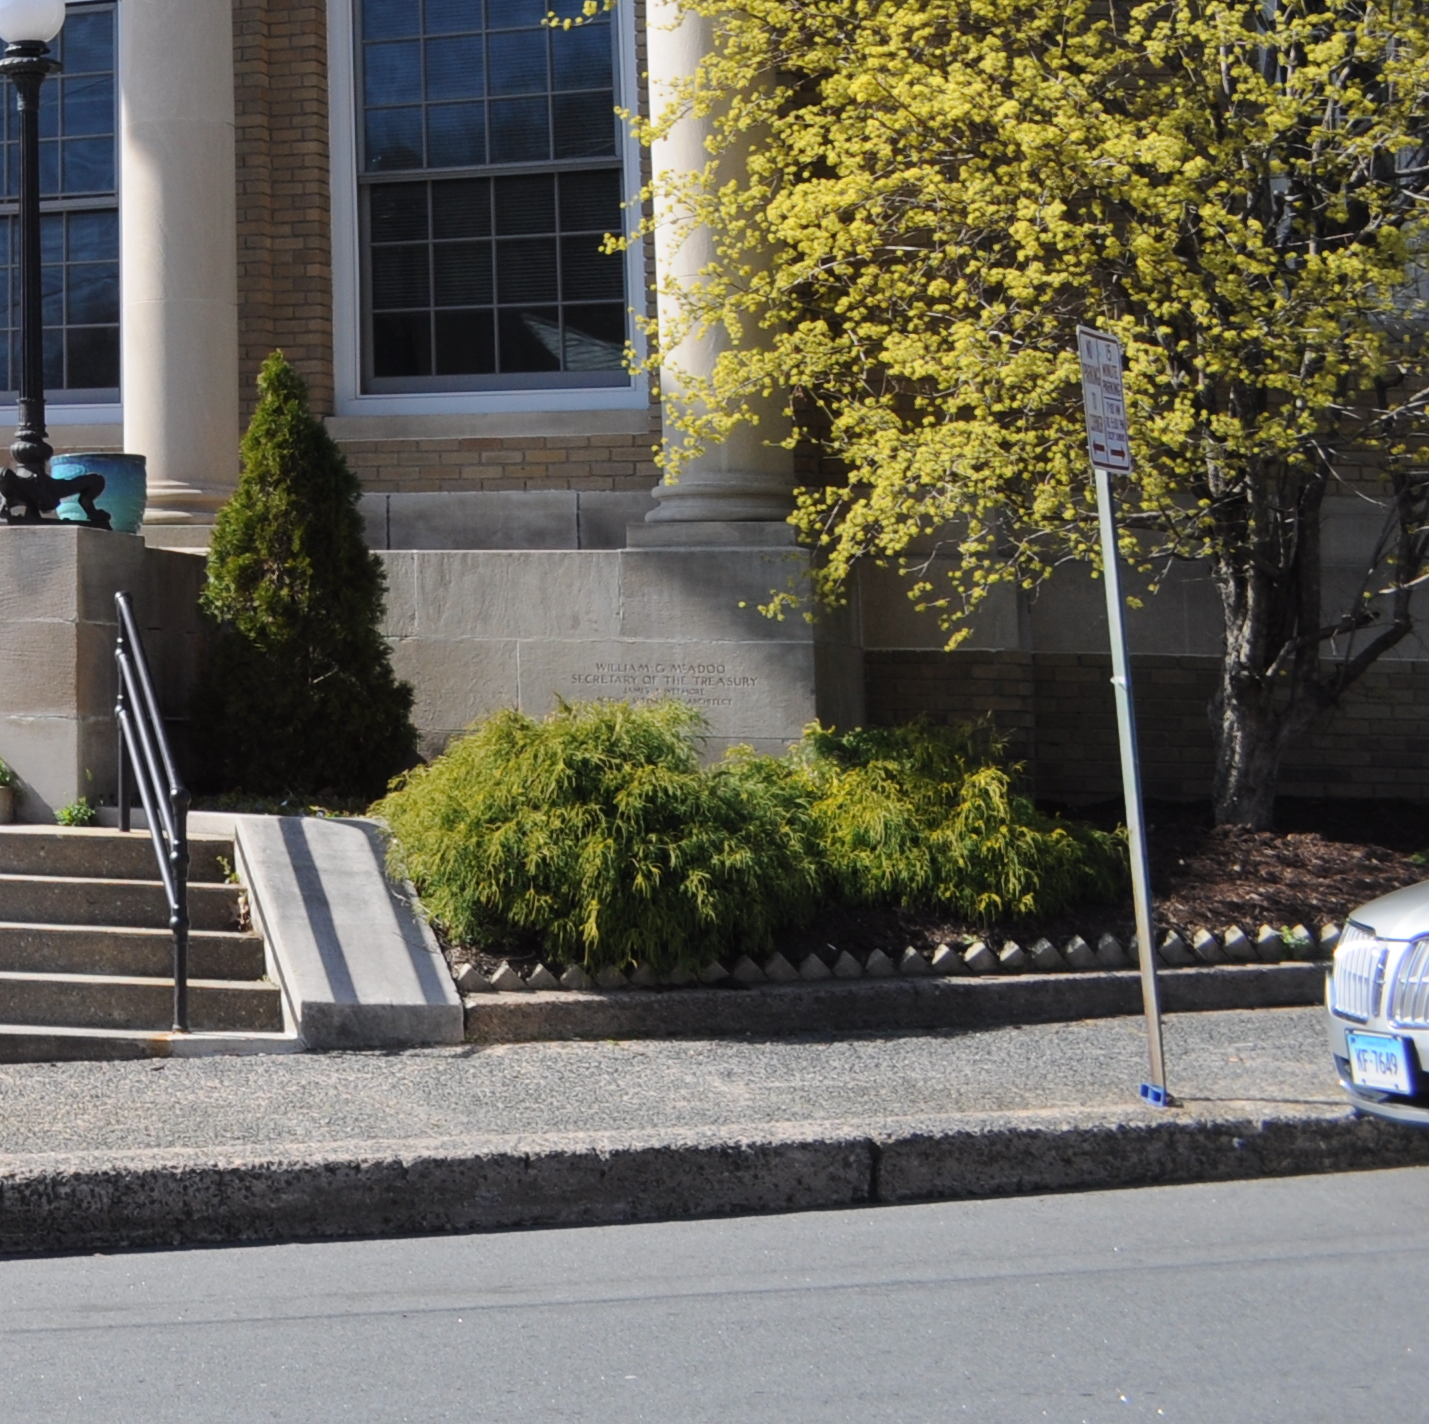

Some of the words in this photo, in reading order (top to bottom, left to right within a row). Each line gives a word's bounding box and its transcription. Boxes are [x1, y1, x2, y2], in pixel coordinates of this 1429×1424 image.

[596, 663, 650, 673] WILLIAM
[571, 674, 637, 685] SECRETARY
[642, 675, 657, 685] OF
[664, 676, 687, 686] THE
[692, 677, 758, 687] TREASURY
